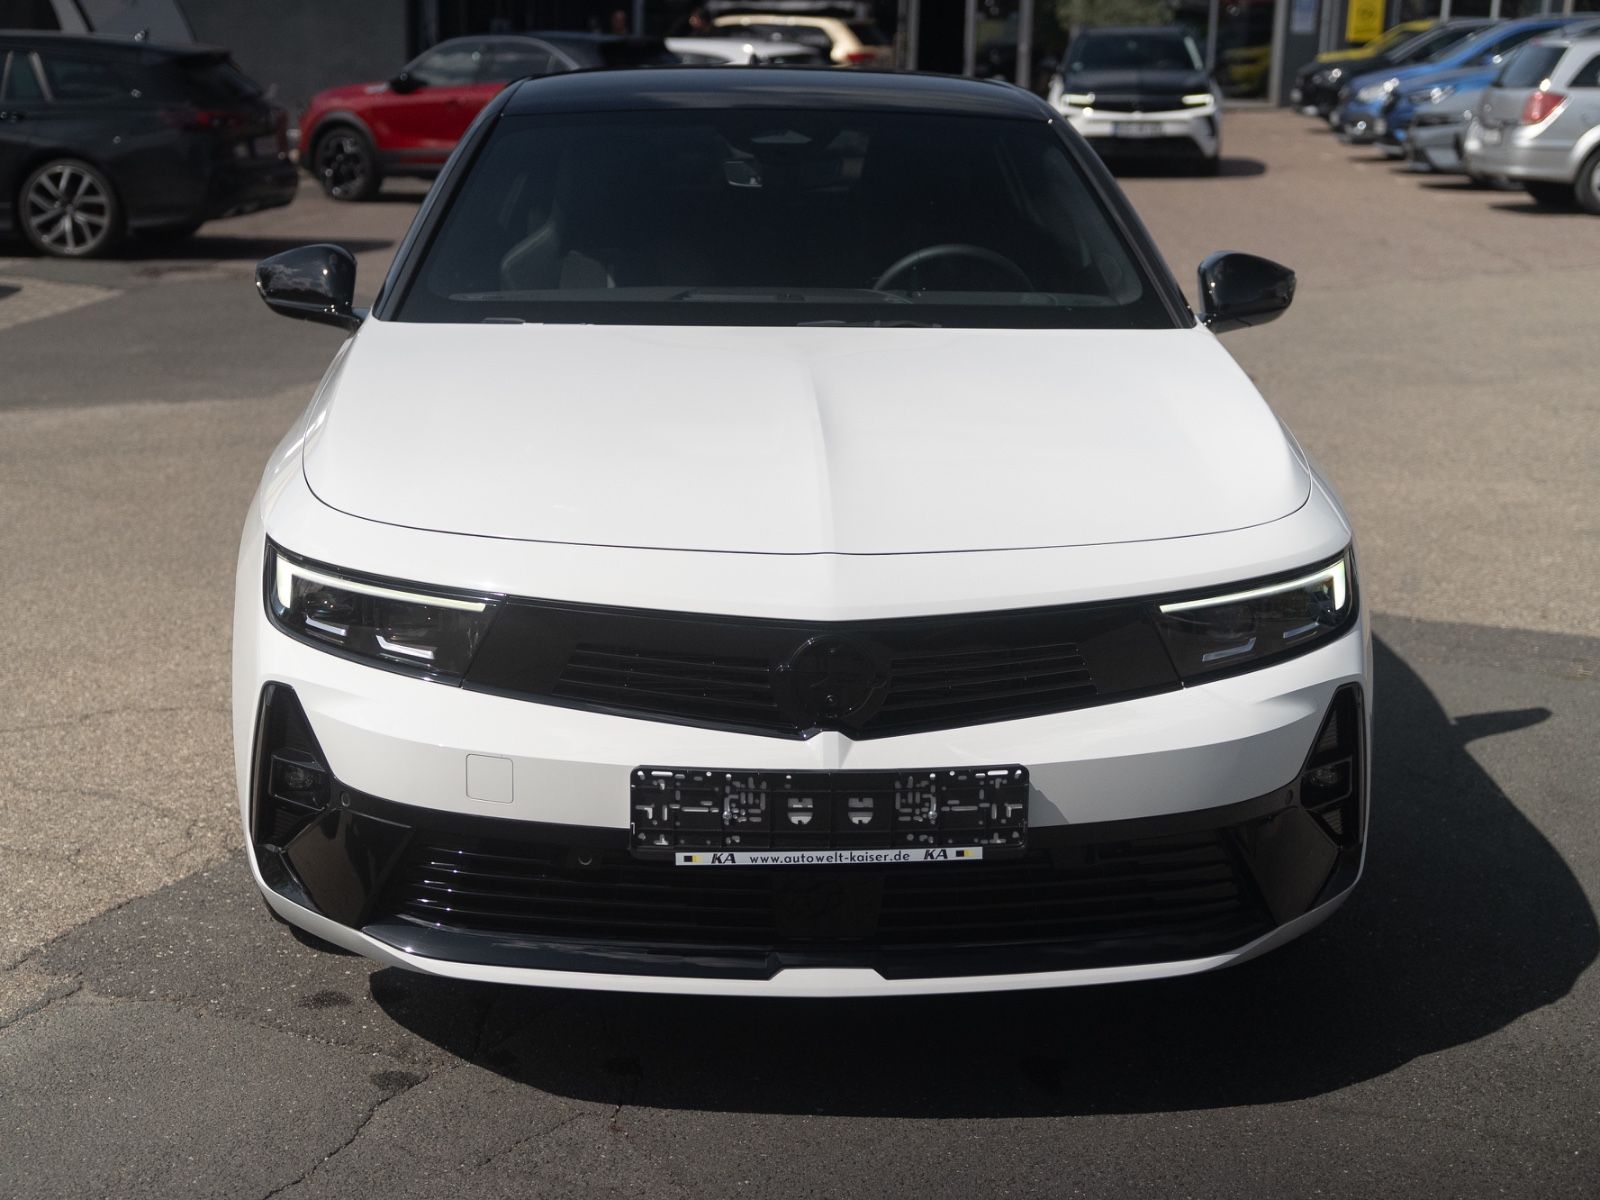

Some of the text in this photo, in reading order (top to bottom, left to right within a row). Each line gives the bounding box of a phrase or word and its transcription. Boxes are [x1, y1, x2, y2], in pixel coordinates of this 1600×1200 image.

[711, 849, 949, 864] KA www.autowelt-kaiser.de KA
